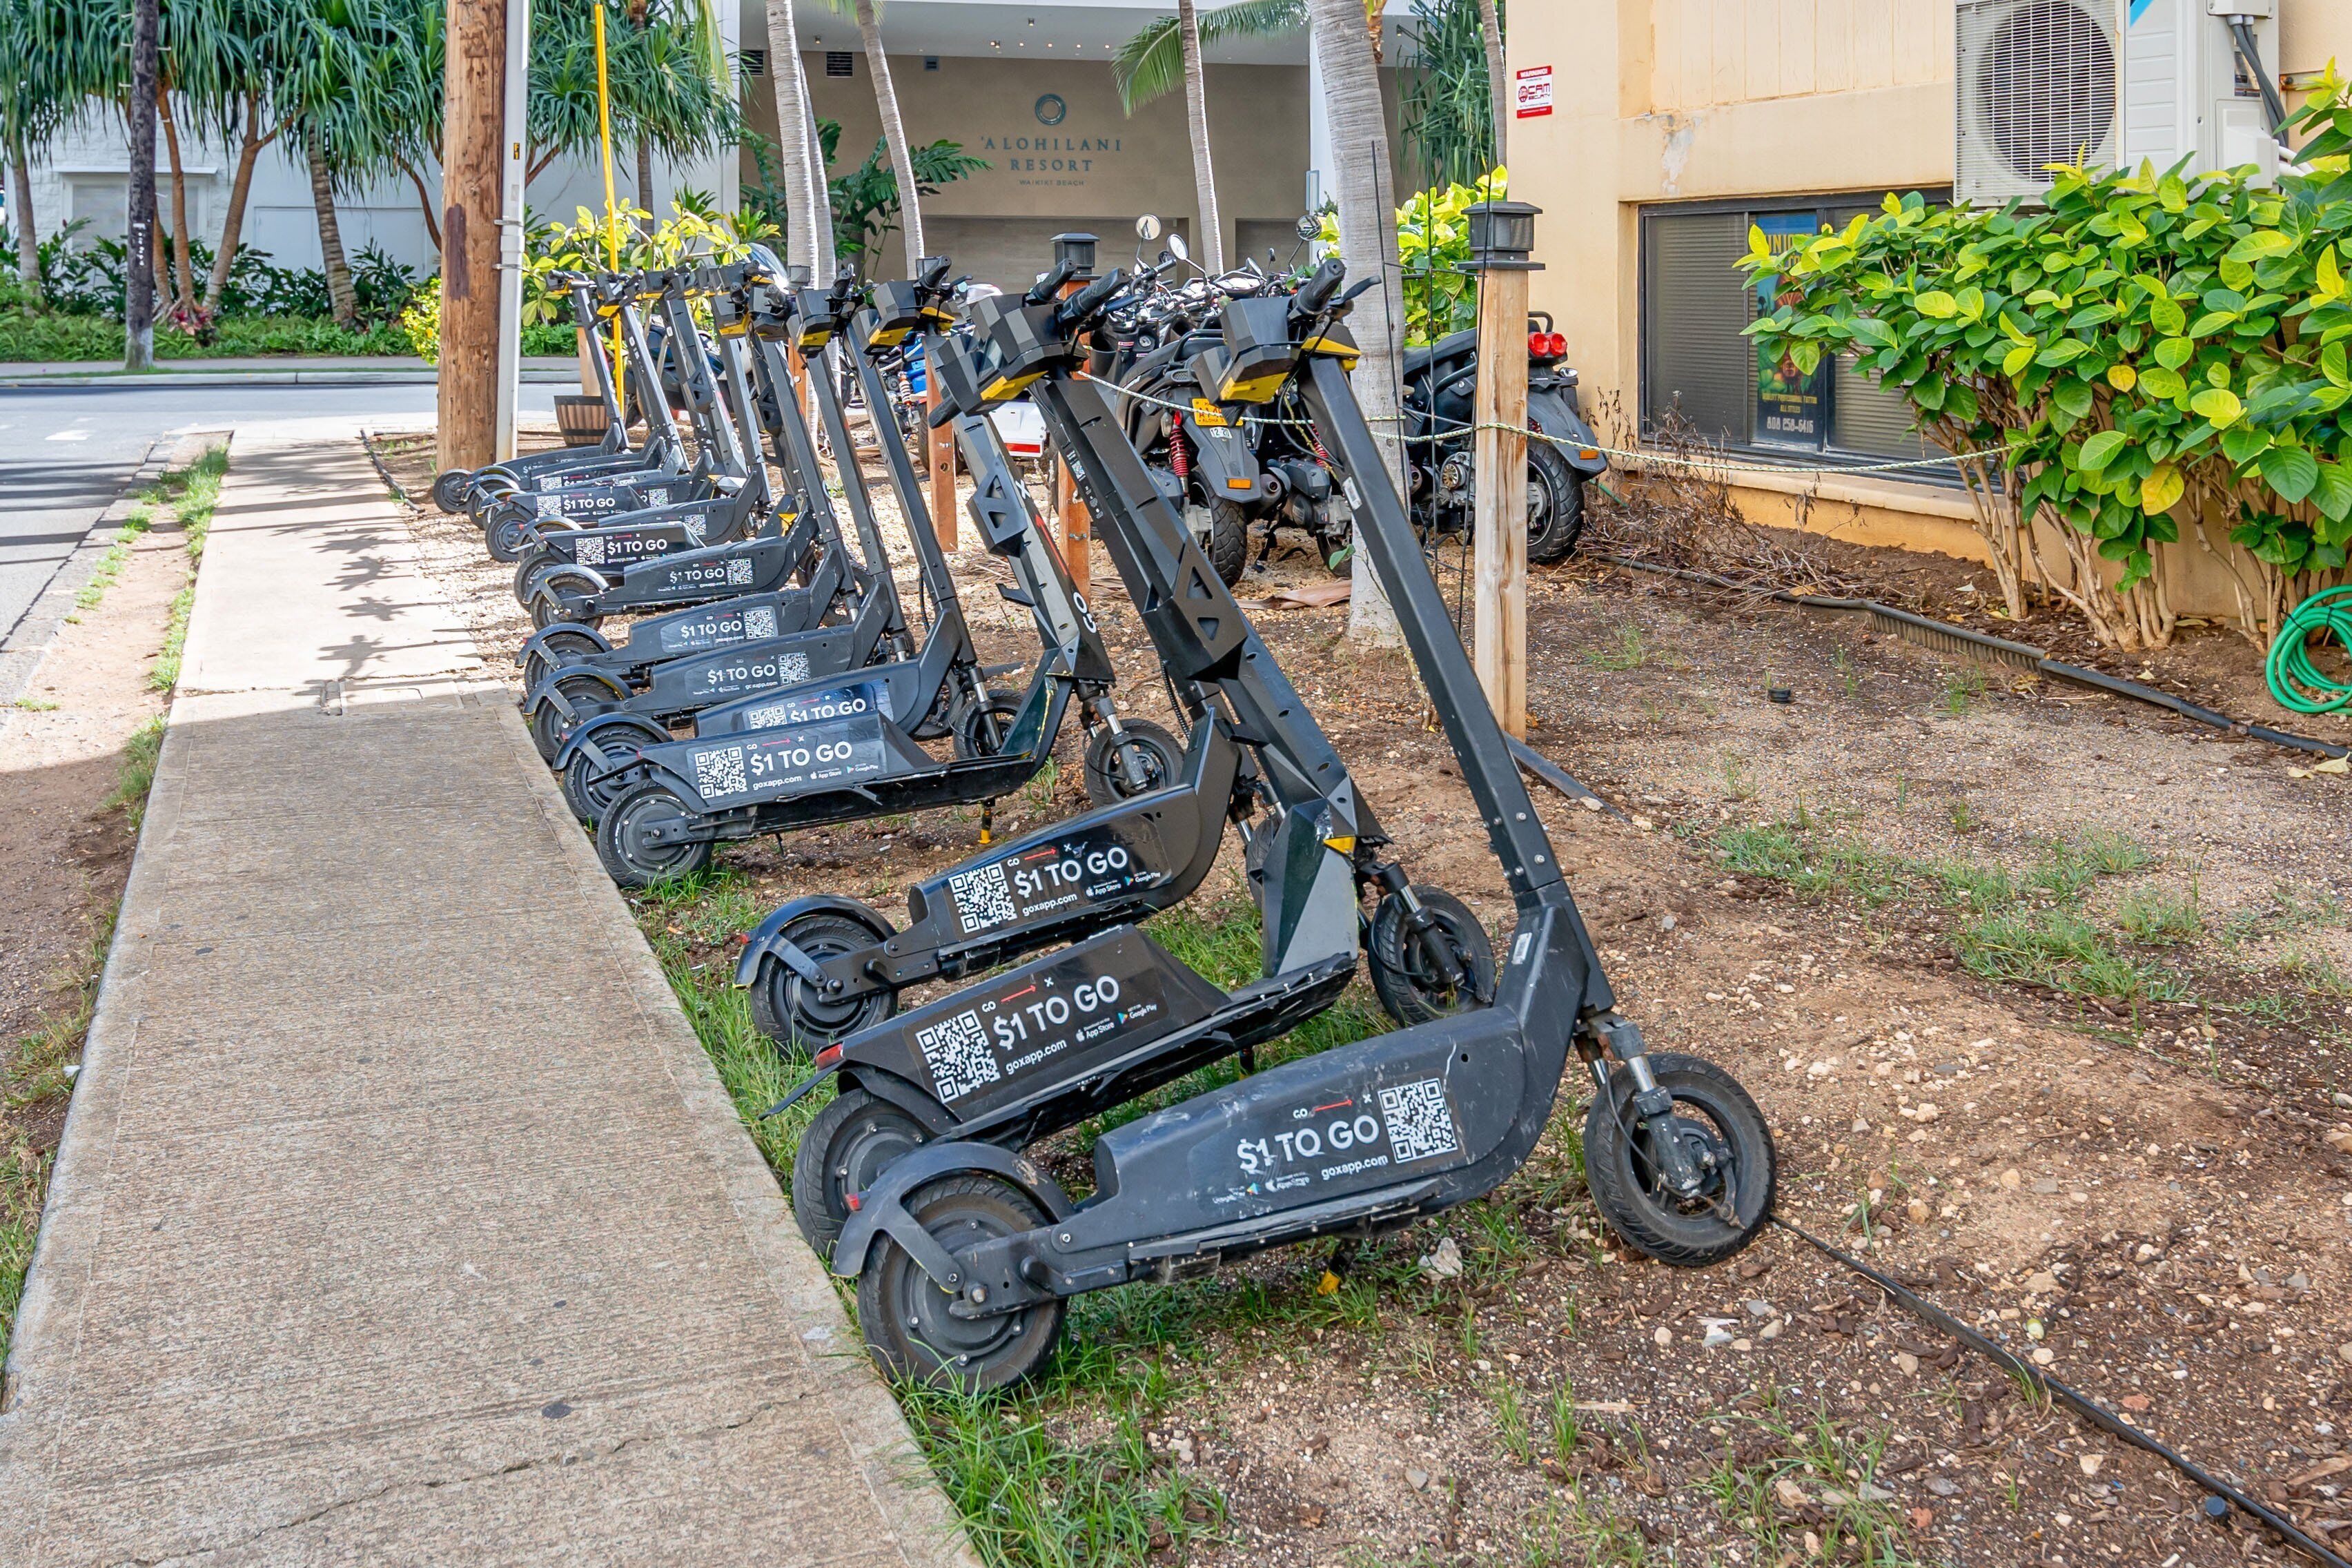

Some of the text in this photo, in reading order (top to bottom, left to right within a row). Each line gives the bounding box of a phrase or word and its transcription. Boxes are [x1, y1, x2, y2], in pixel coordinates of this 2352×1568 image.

[1520, 68, 1548, 77] WARNING!
[1528, 83, 1550, 95] CAM
[1010, 158, 1092, 171] RESORT
[1767, 416, 1781, 430] 808
[564, 498, 616, 511] $1 TO GO
[607, 539, 667, 556] $1 TO GO
[685, 570, 702, 581] TO
[705, 568, 725, 579] GO
[680, 620, 742, 638] $1 TO GO
[707, 664, 776, 685] $1 TO GO
[790, 698, 866, 723] $1 TO GO
[750, 741, 852, 776] $1 TO GO
[752, 775, 803, 791] goxapp.com
[1007, 843, 1072, 868] GO X
[1014, 847, 1128, 898] $1 TO GO
[1135, 874, 1151, 883] Google
[1095, 888, 1106, 896] App
[1106, 883, 1121, 892] Store
[1022, 892, 1078, 917] goxapp.com
[981, 977, 1054, 1012] GO X
[993, 975, 1119, 1050] $1 TO GO
[1129, 1008, 1146, 1019] Google
[1146, 1003, 1157, 1013] Play
[1086, 1021, 1115, 1039] App Store
[1006, 1038, 1068, 1075] goxapp.com
[1293, 1094, 1372, 1119] GO X
[1237, 1115, 1379, 1175] $1 TO GO
[1321, 1153, 1389, 1180] goxapp.com
